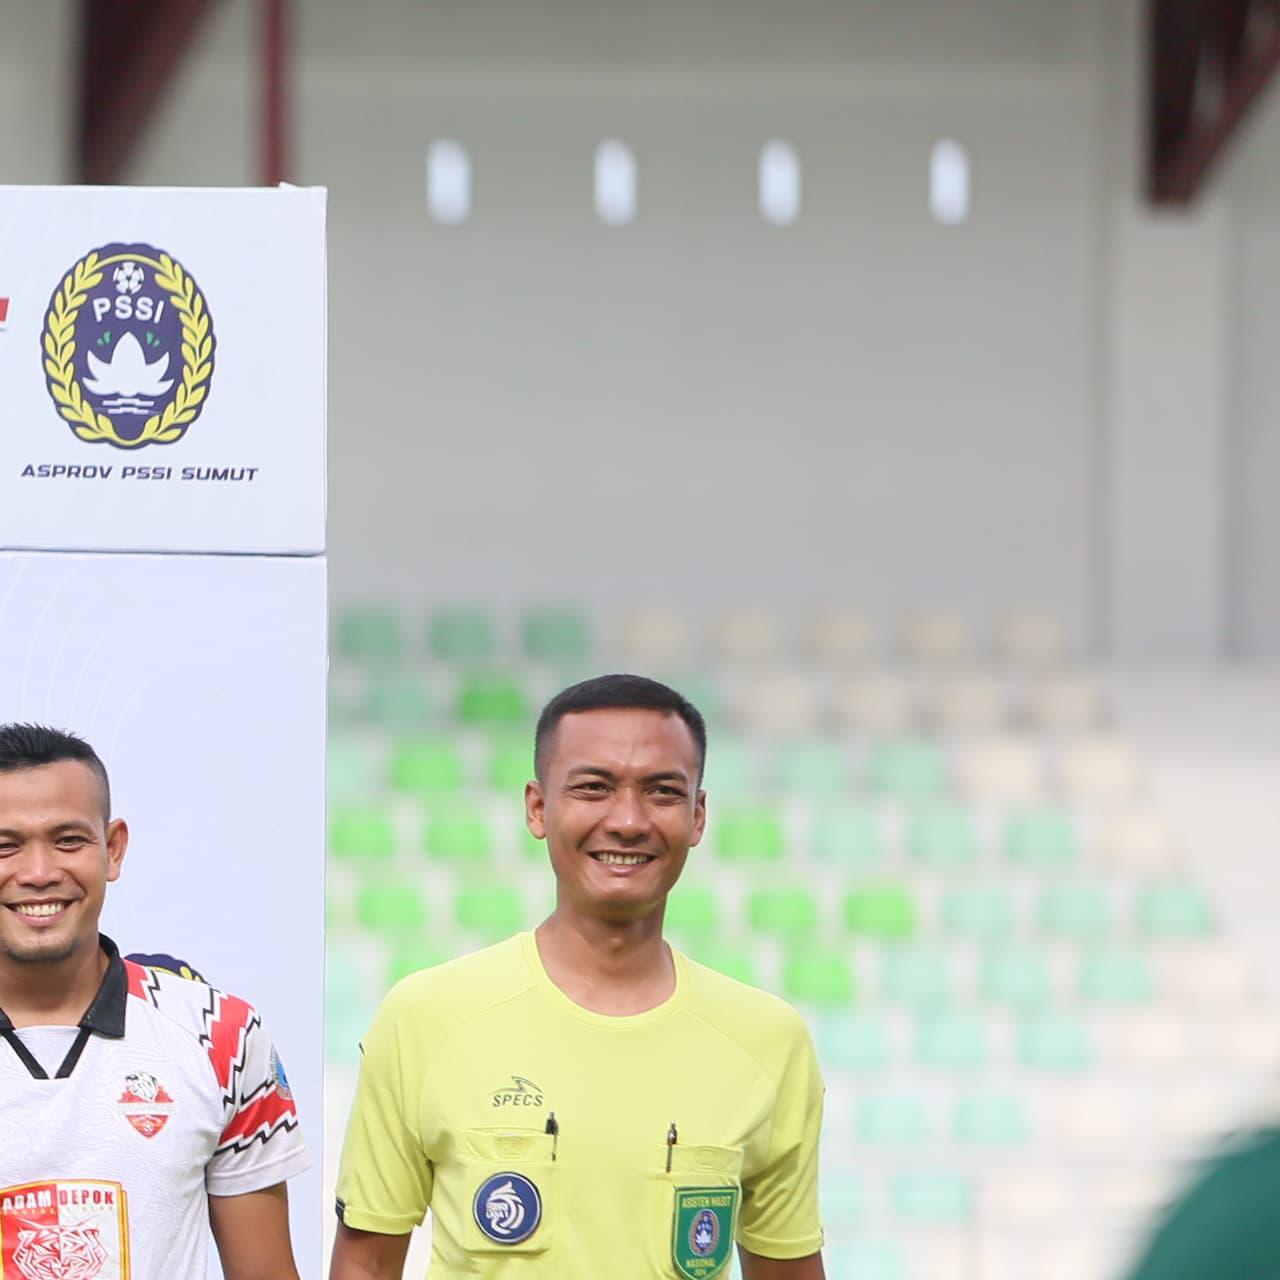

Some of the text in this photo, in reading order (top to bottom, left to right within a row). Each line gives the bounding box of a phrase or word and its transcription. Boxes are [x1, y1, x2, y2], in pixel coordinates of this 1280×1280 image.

[92, 295, 165, 324] PSSI
[21, 464, 259, 481] ASPROV PSSI SUMUT
[492, 1094, 543, 1108] SPECS
[59, 1189, 115, 1206] DEPOK
